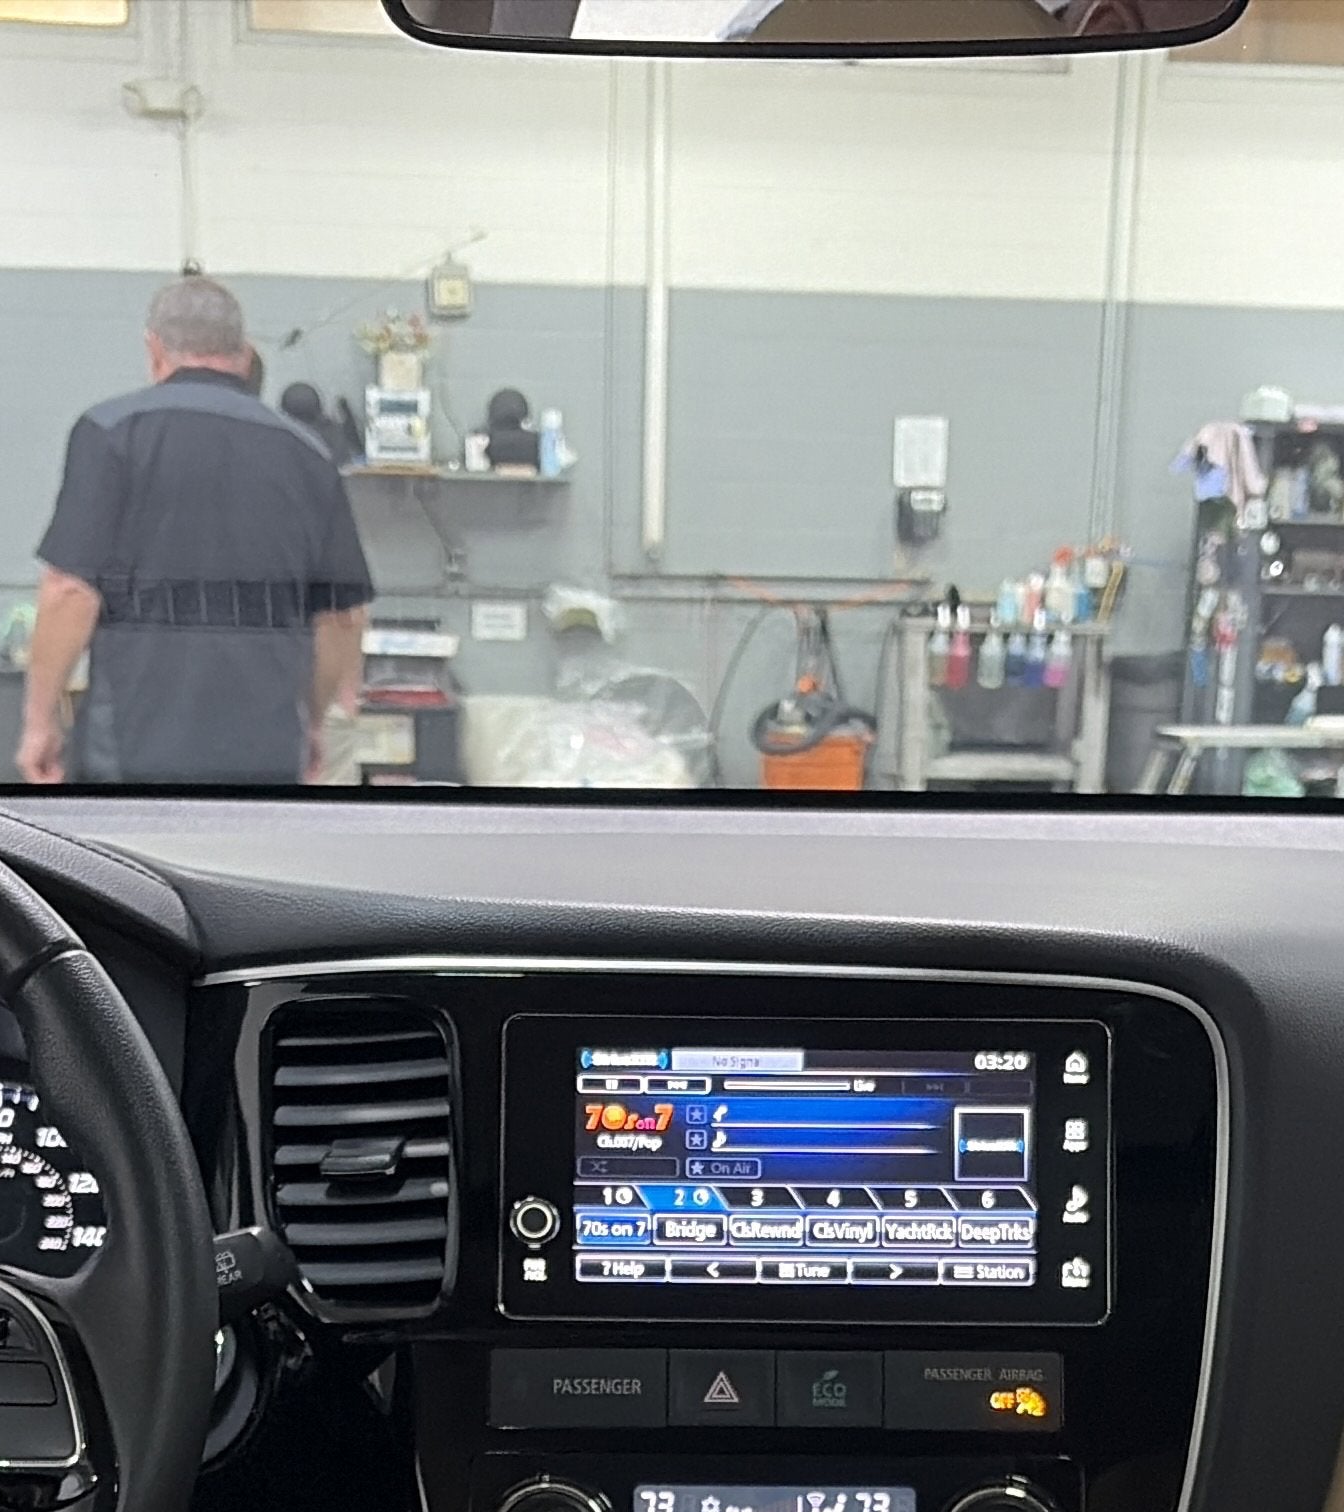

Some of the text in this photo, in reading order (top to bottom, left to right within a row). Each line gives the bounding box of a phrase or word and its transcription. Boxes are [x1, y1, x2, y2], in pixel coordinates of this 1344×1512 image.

[974, 1053, 1028, 1071] 03:20
[711, 1161, 752, 1174] On Air
[602, 1187, 613, 1205] 1
[674, 1188, 686, 1206] 2
[751, 1189, 765, 1206] 3
[826, 1189, 842, 1208] 4
[904, 1190, 918, 1208] 5
[981, 1190, 995, 1209] 6
[582, 1220, 647, 1238] 70s on 7
[665, 1221, 717, 1242] Bridge
[812, 1222, 874, 1243] ClsVinyl
[885, 1223, 955, 1241] YachtRck
[961, 1224, 1032, 1244] DeepTrks
[612, 1262, 645, 1278] Help
[795, 1263, 831, 1278] Tune
[976, 1265, 1026, 1280] Station
[924, 1368, 1043, 1381] PASSENGER AIRBAG
[553, 1379, 642, 1395] PASSENGER
[812, 1382, 846, 1398] ECO
